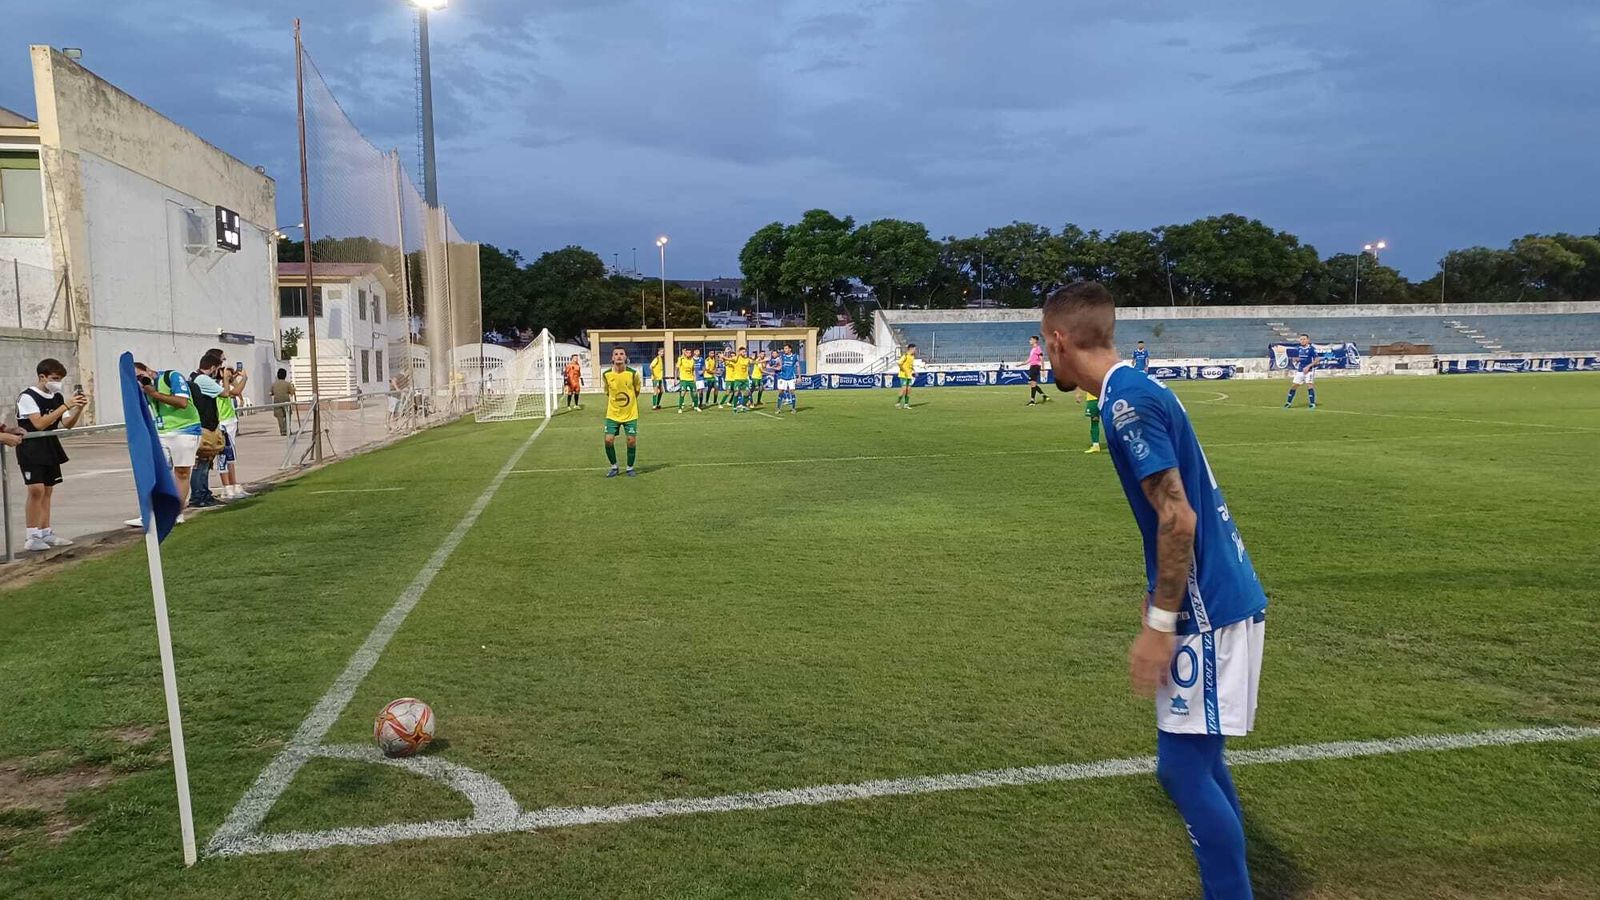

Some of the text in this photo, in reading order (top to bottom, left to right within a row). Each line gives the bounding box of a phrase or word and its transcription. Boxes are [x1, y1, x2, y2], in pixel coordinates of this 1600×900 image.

[853, 376, 874, 384] BACO
[1190, 591, 1206, 625] XEREZ
[1205, 657, 1214, 693] XEREZ
[1205, 698, 1218, 735] XEREZ
